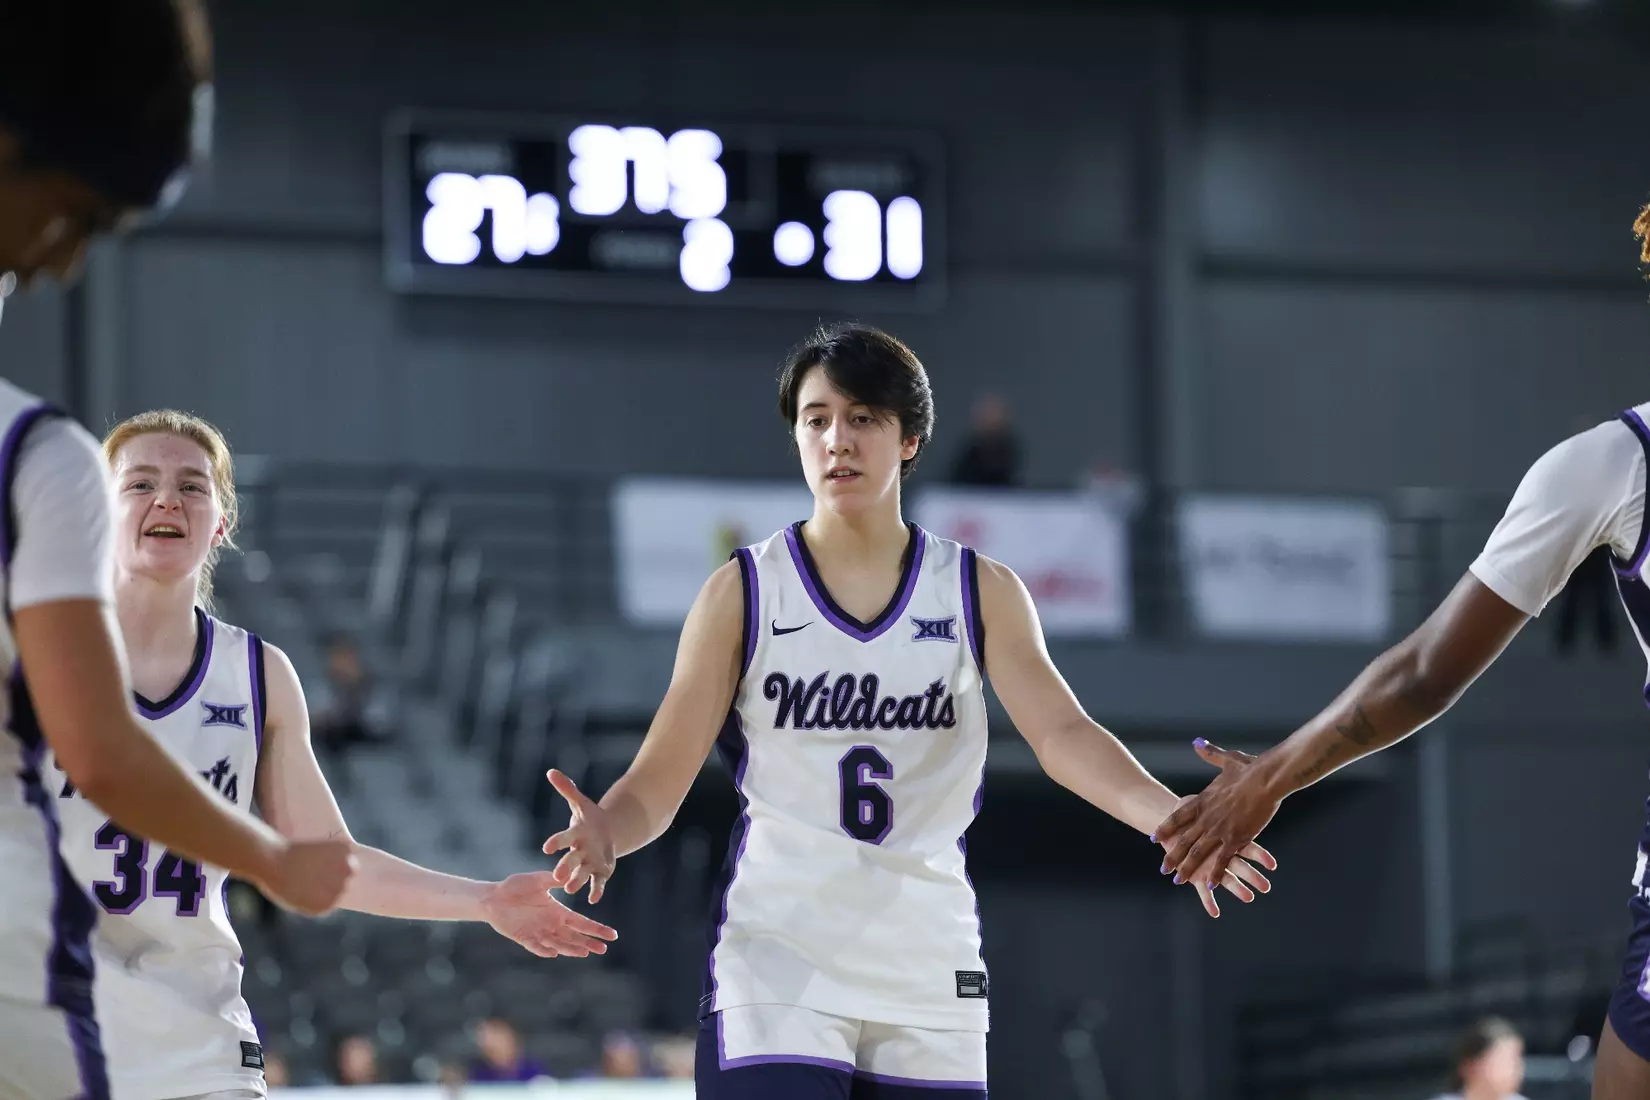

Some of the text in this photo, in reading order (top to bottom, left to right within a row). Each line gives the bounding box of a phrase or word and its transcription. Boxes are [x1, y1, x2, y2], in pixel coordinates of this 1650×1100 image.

[824, 190, 923, 281] 31
[911, 616, 958, 643] XII
[201, 702, 248, 730] XII
[763, 670, 957, 731] Wildcats
[837, 745, 894, 846] 6
[92, 817, 207, 917] 34
